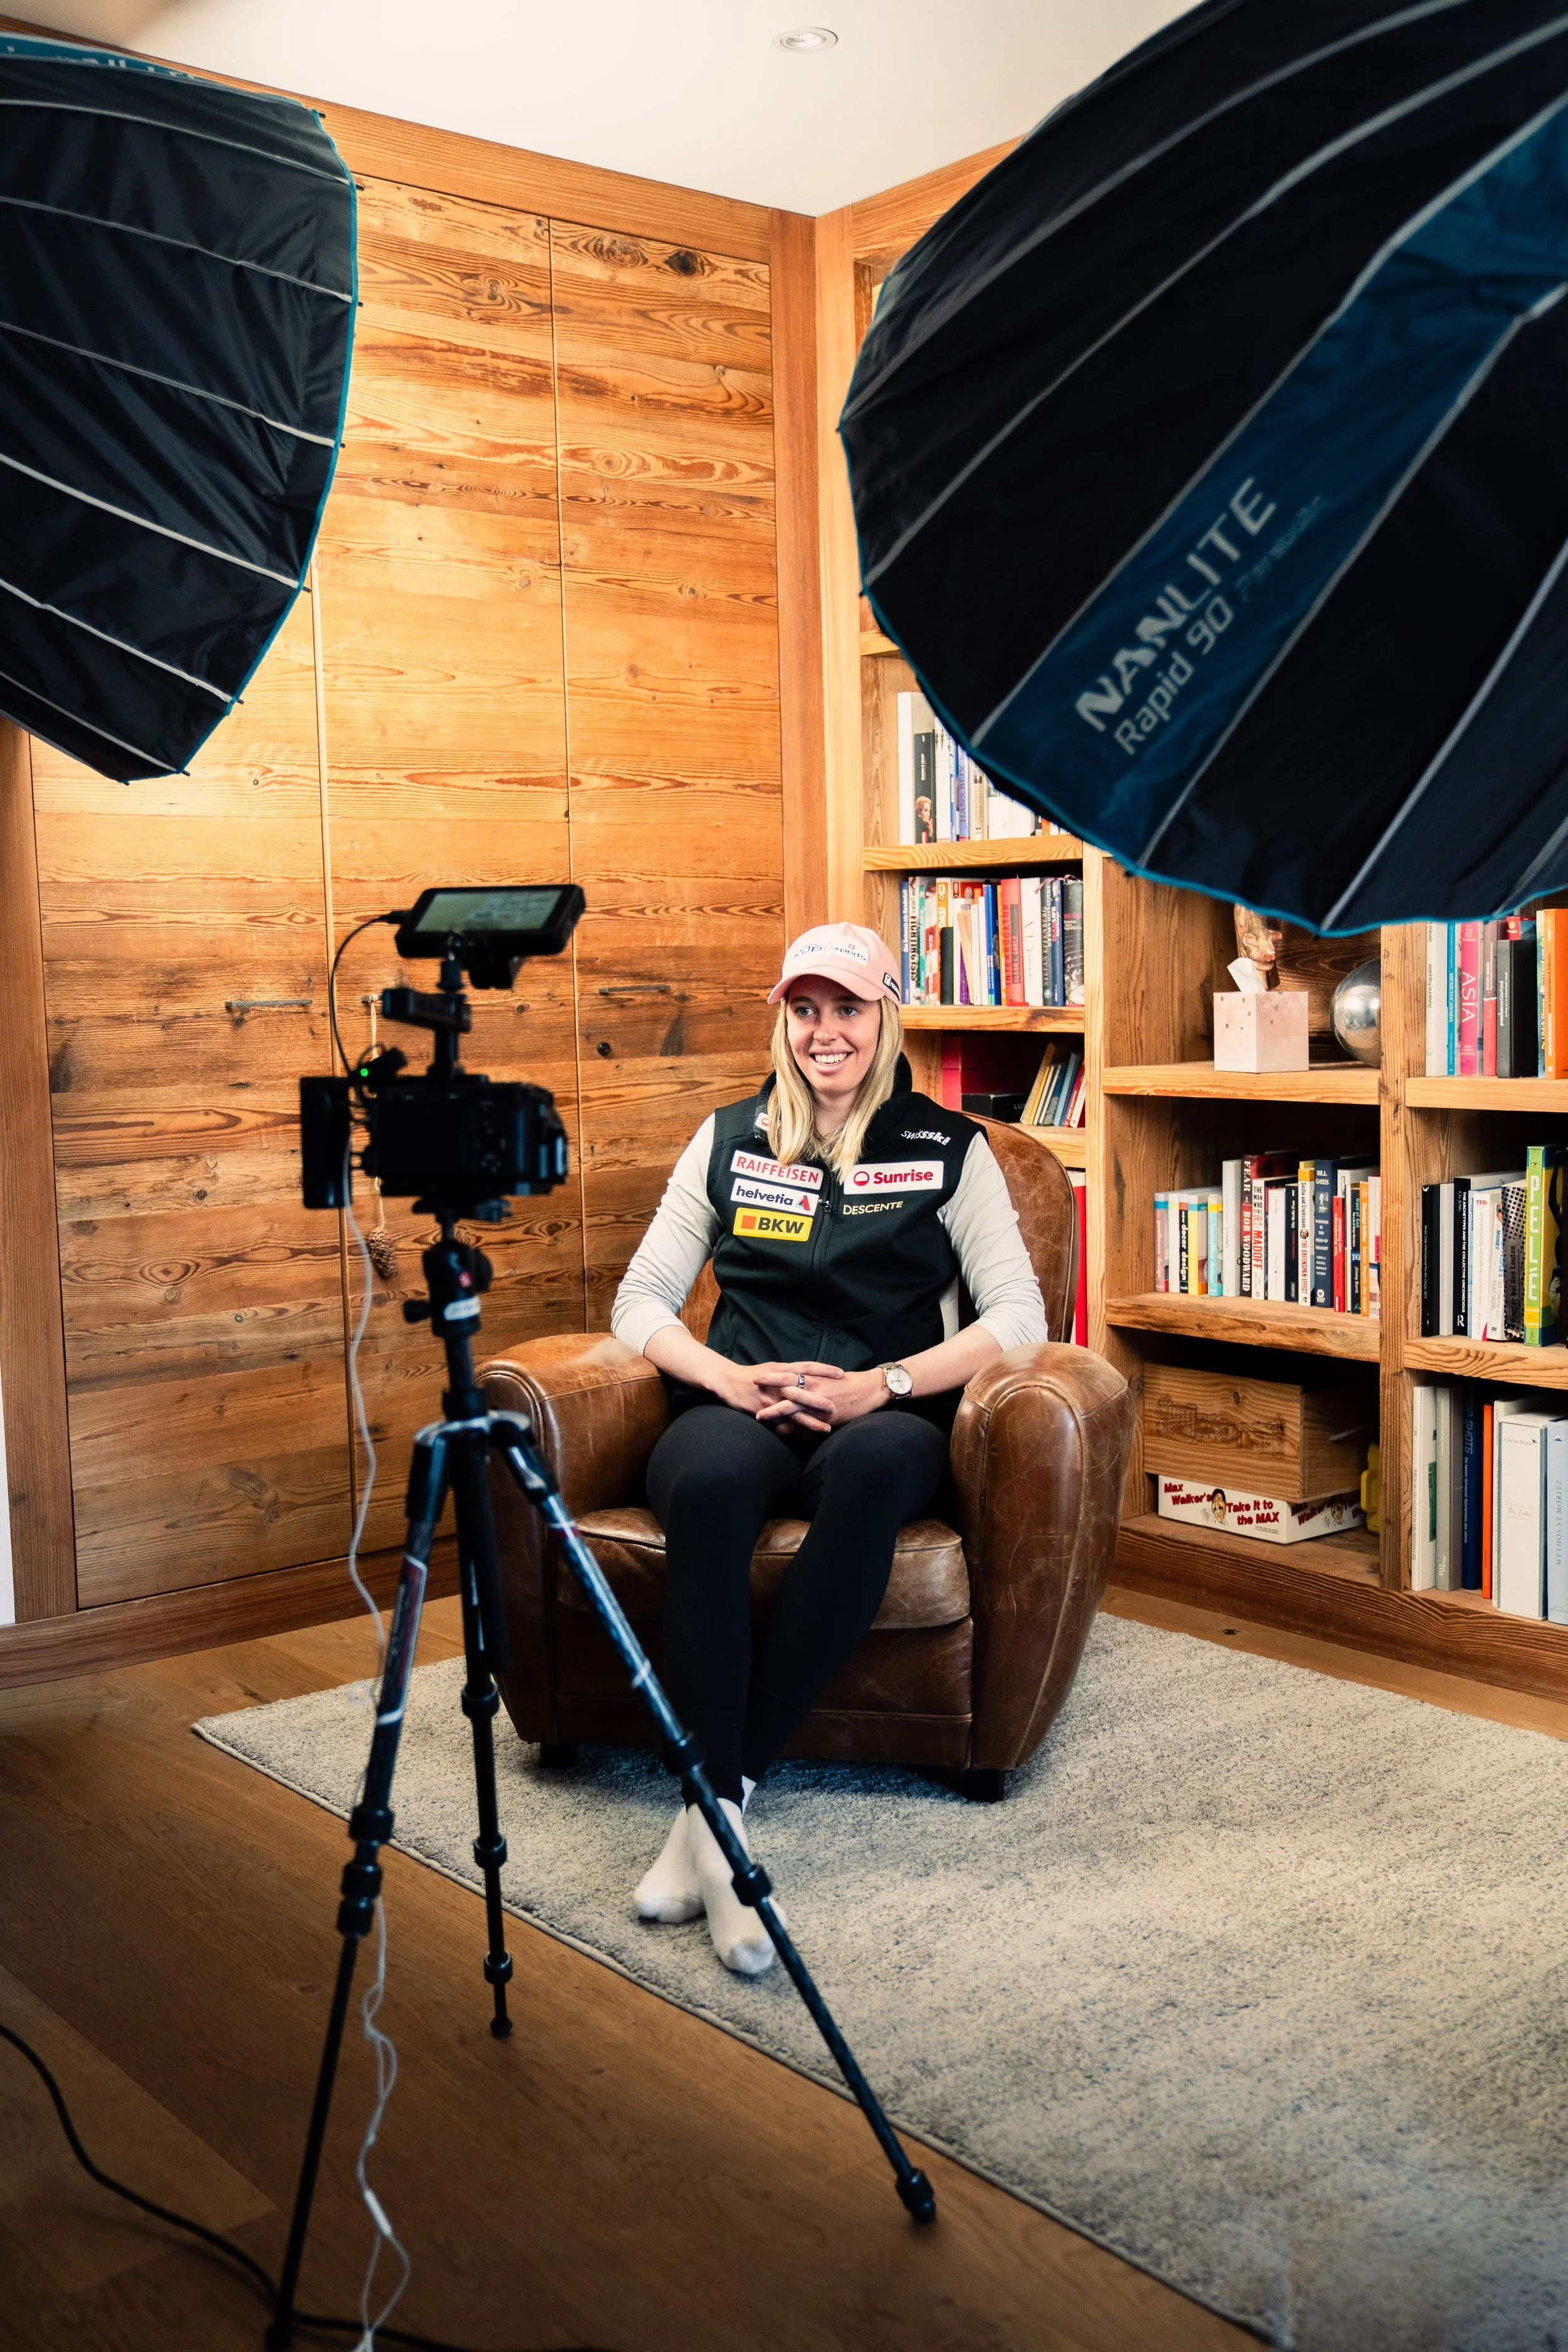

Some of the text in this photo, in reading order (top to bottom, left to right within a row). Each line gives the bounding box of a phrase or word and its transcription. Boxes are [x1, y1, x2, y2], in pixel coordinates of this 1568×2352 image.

[1075, 477, 1276, 732] NANLITE
[1114, 650, 1194, 755] Rapid
[1186, 595, 1233, 656] 90
[1003, 904, 1012, 985] INTERROGATOR
[1024, 921, 1034, 951] CIA
[736, 1157, 818, 1184] RAIFFEISEN
[874, 1168, 933, 1184] Sunrise
[736, 1185, 793, 1206] helvetia
[843, 1200, 903, 1215] DESCENTE
[758, 1217, 804, 1234] BKW
[1253, 1230, 1263, 1269] MADOFF
[1242, 1234, 1251, 1291] WOODWARD
[1465, 1419, 1473, 1454] SHOTS
[1164, 1483, 1183, 1493] Max
[1172, 1492, 1212, 1505] Walker's
[1226, 1502, 1251, 1513] Take
[1263, 1499, 1273, 1510] to
[1237, 1512, 1279, 1525] the MAX
